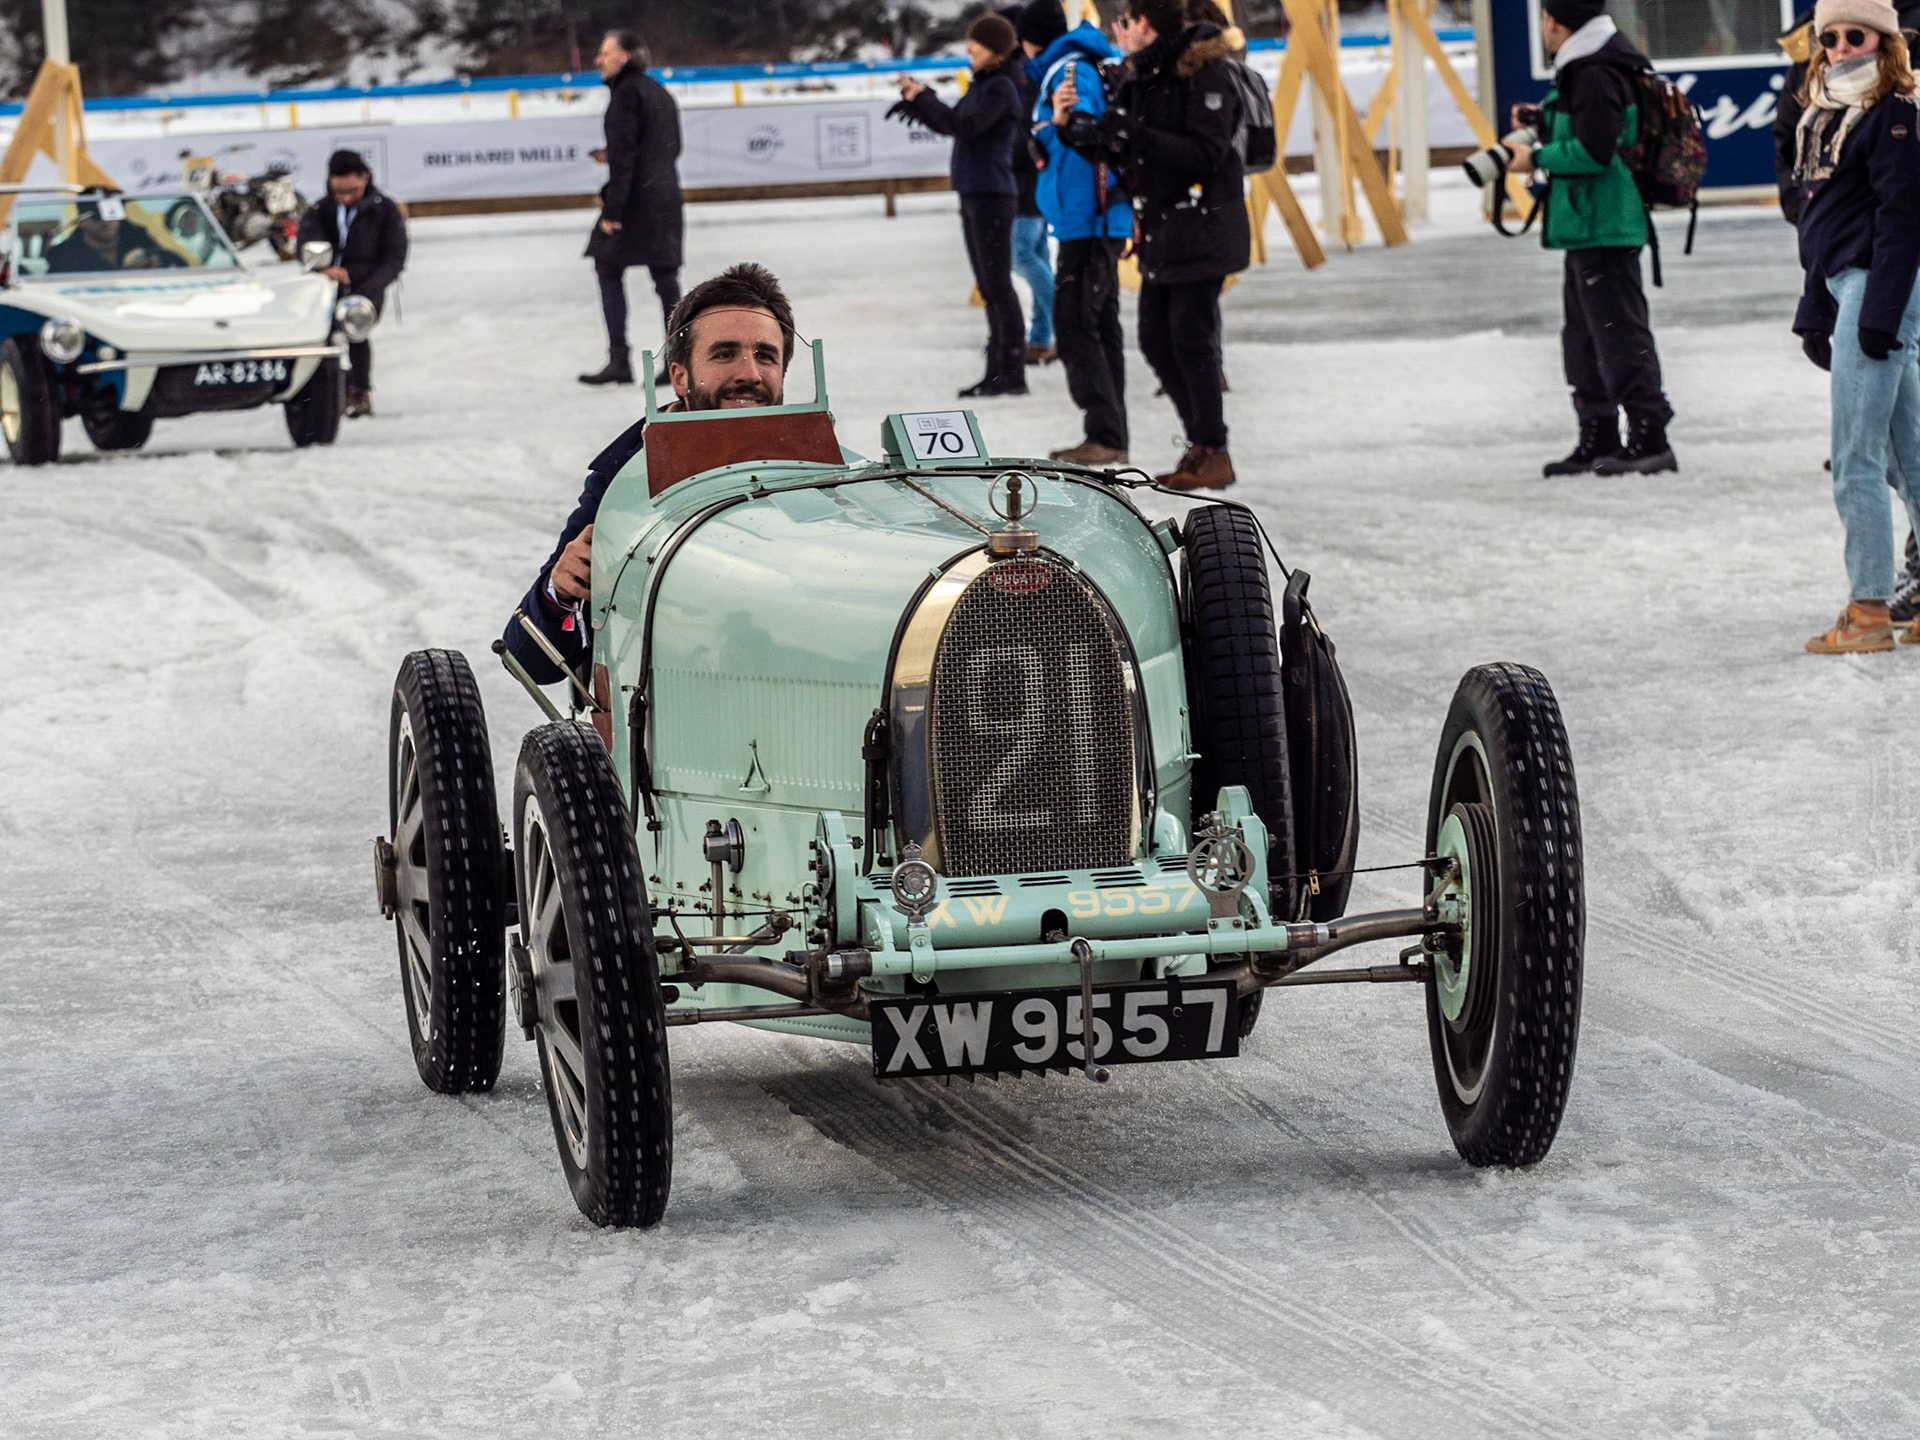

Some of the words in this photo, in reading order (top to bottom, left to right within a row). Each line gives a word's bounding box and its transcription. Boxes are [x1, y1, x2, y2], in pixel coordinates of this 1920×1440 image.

[827, 123, 859, 138] THE
[424, 149, 514, 168] RICHARD
[519, 145, 579, 163] MILLE
[918, 431, 964, 454] 70
[929, 895, 1011, 930] XW
[1066, 884, 1200, 919] 9557
[882, 1000, 994, 1073] XW
[1011, 987, 1228, 1065] 9557
